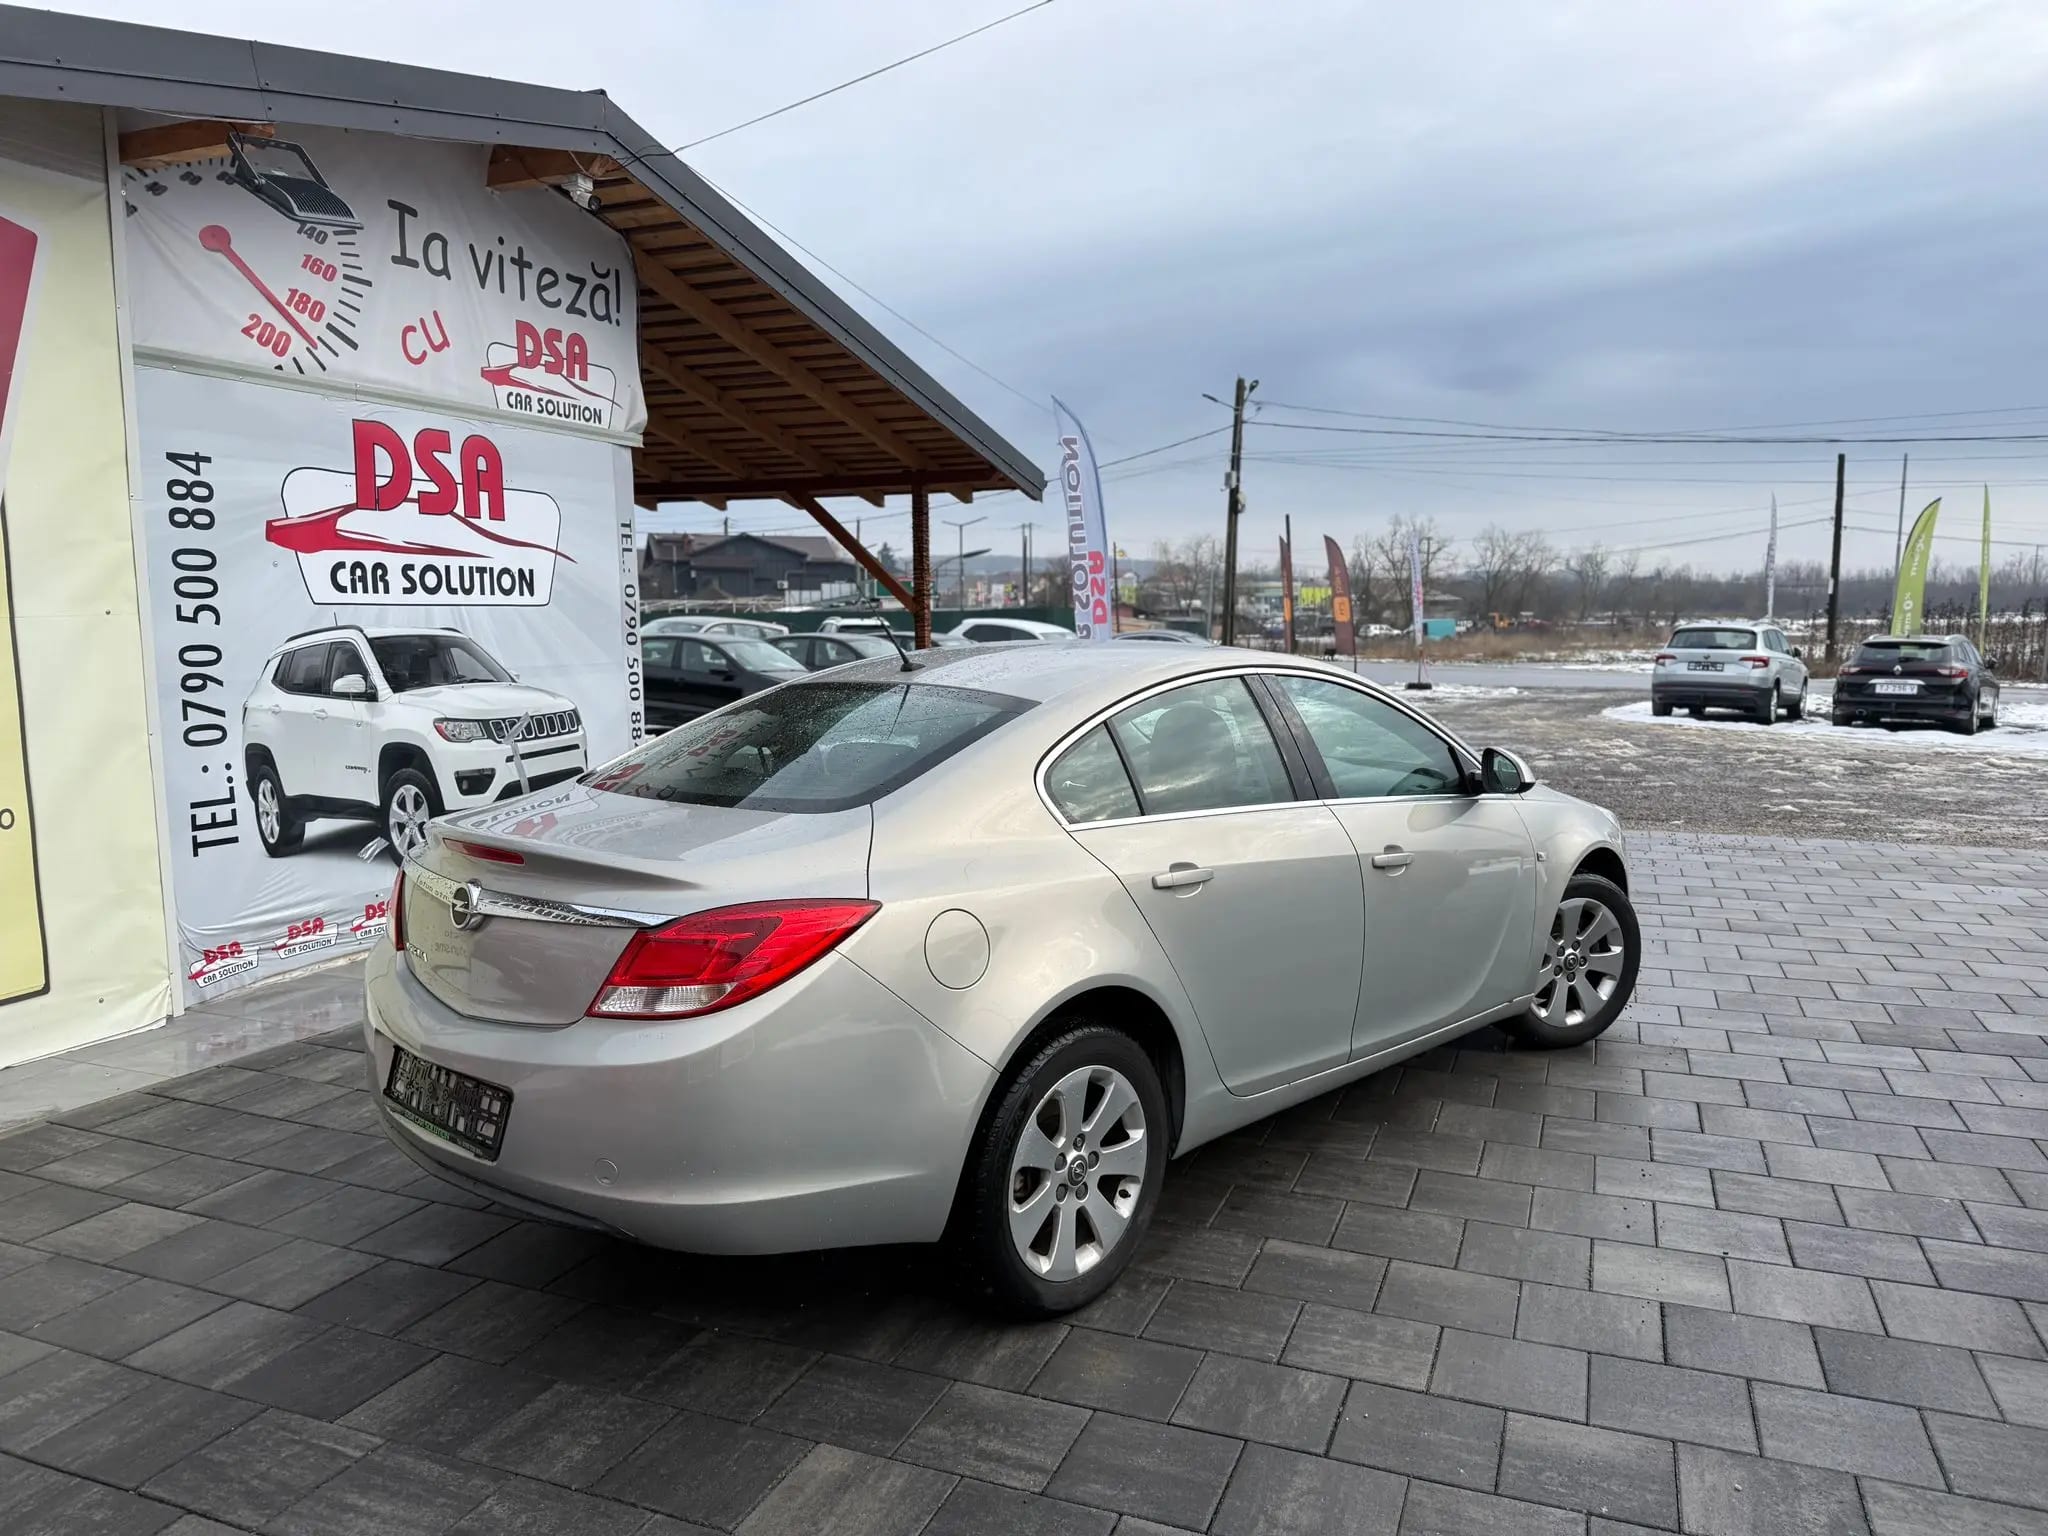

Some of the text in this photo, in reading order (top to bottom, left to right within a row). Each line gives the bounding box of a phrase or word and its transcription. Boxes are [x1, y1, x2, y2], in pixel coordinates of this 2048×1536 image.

[297, 222, 329, 245] 140
[300, 253, 338, 282] 160
[387, 199, 621, 327] Ia viteză!
[285, 287, 327, 323] 180
[240, 313, 292, 358] 200
[401, 310, 451, 366] cu
[516, 319, 589, 382] DSA
[507, 391, 603, 425] CAR SOLUTION
[352, 418, 506, 521] DSA
[330, 560, 535, 598] CAR SOLUTION
[624, 583, 639, 646] 0790
[165, 451, 240, 858] TEL.: 0790 500 884
[627, 657, 641, 702] 500
[287, 916, 325, 940] DSA
[365, 899, 390, 921] DS
[203, 941, 244, 965] DSA
[283, 938, 333, 956] CAR SOLUTION
[203, 959, 254, 984] CAR SOLUTION
